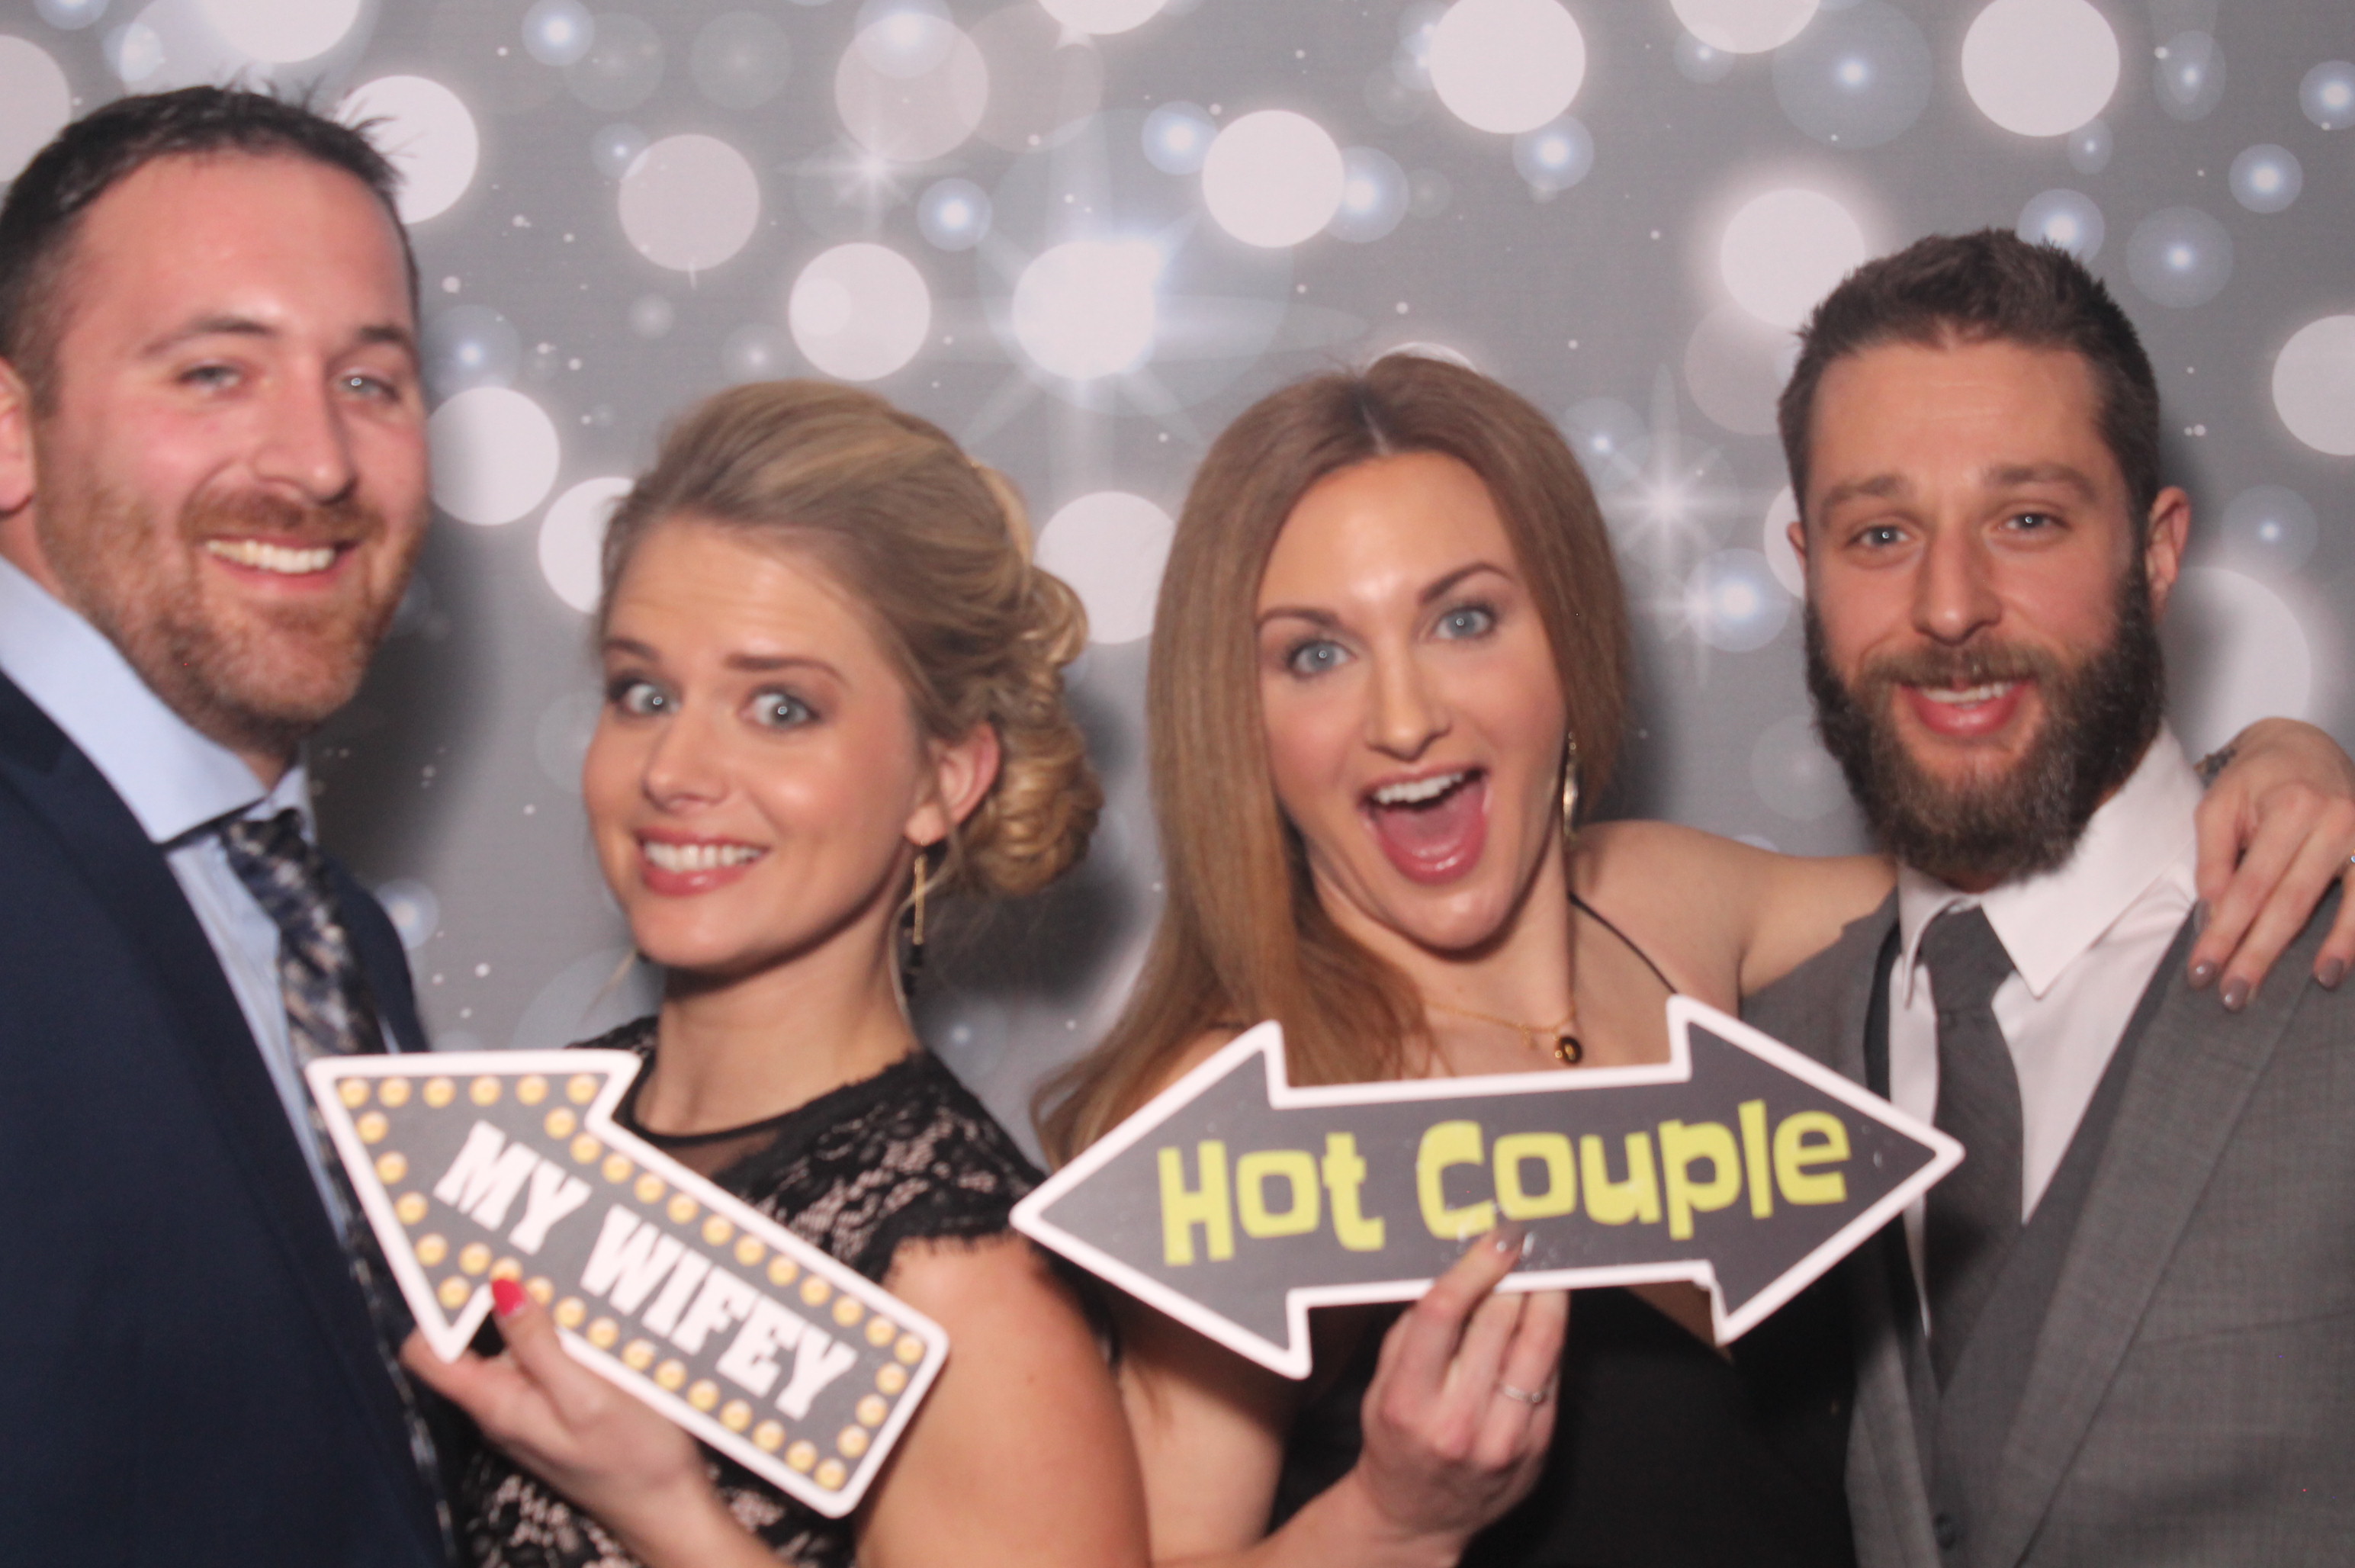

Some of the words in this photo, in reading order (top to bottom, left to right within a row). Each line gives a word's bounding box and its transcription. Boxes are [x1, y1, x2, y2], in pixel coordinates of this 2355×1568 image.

[434, 1121, 591, 1254] MY
[581, 1205, 856, 1419] WIFEY
[1158, 1133, 1384, 1265] Hot
[1416, 1100, 1851, 1240] Couple
